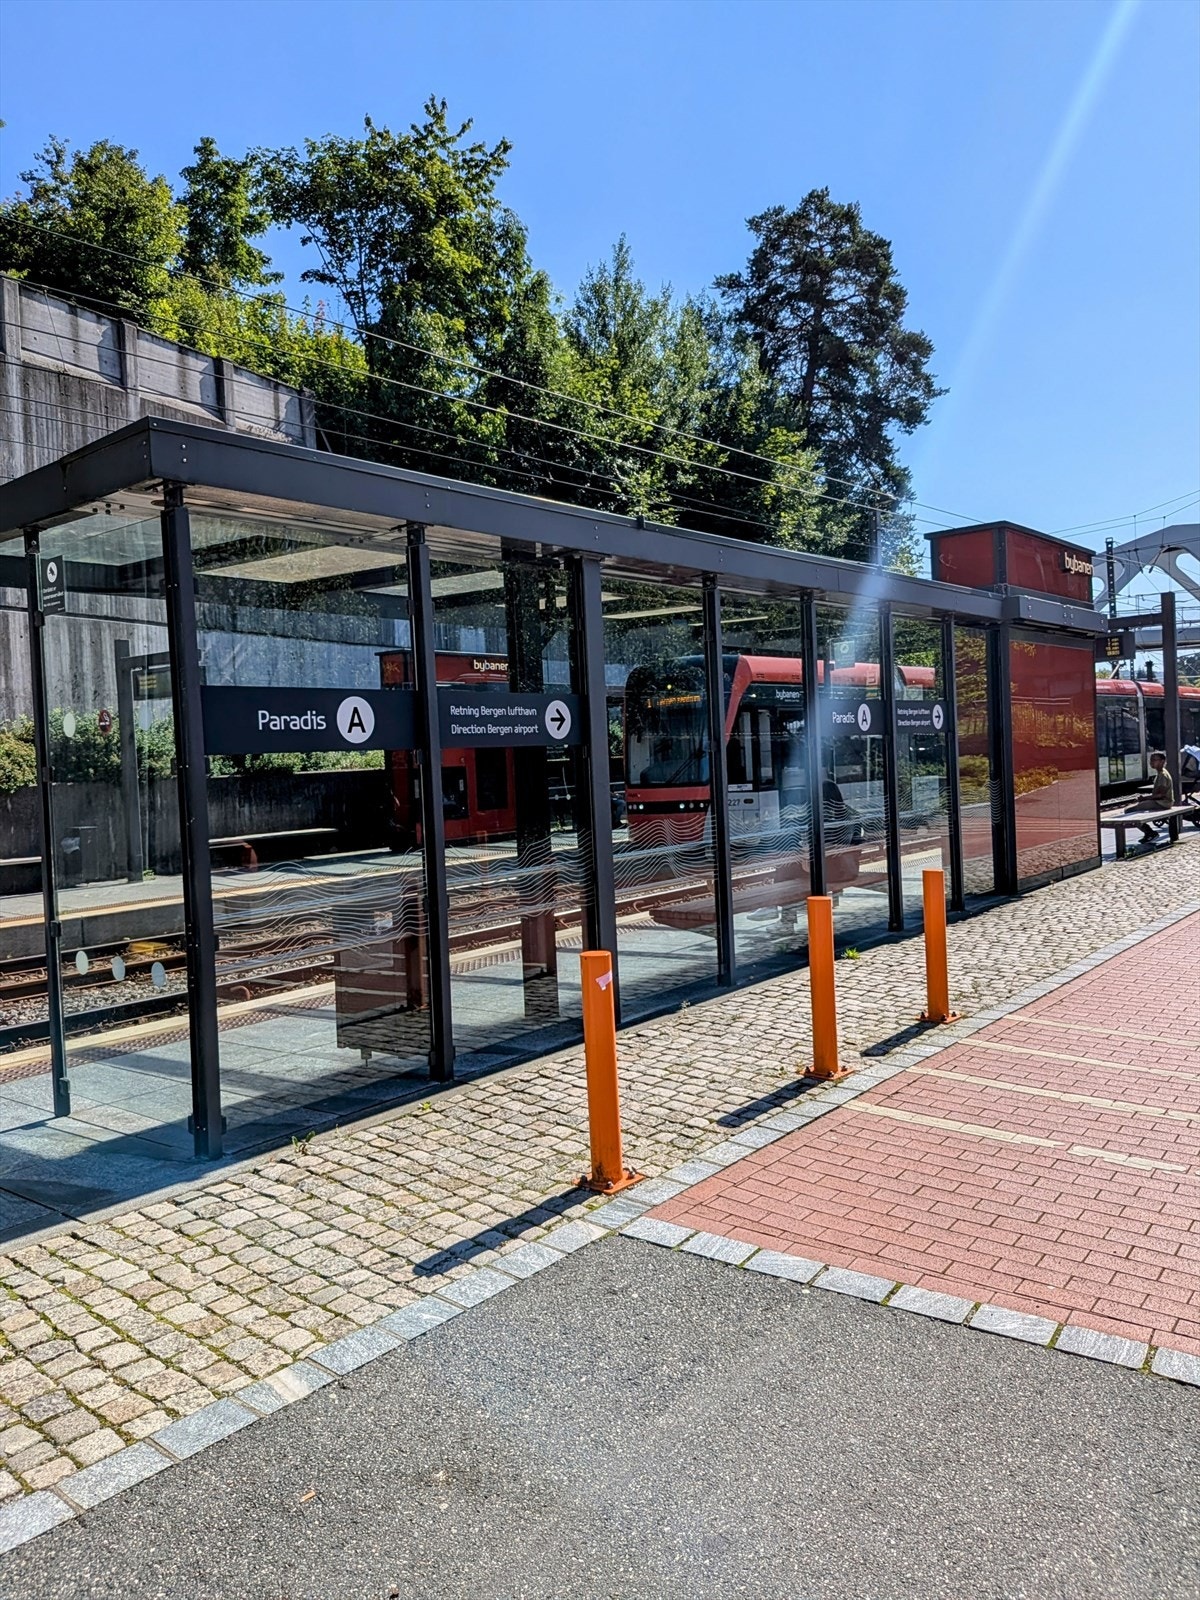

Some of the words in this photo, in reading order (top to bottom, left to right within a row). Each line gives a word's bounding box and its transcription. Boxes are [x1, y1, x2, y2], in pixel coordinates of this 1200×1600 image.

[450, 705, 480, 718] Retning
[480, 705, 507, 718] Bergen
[507, 705, 537, 716] lufthavn
[832, 711, 855, 724] Paradis
[861, 710, 869, 726] A
[257, 710, 327, 730] Paradis
[347, 706, 367, 733] A
[451, 724, 486, 735] Direction
[487, 724, 513, 736] Bergen
[514, 724, 539, 736] airport
